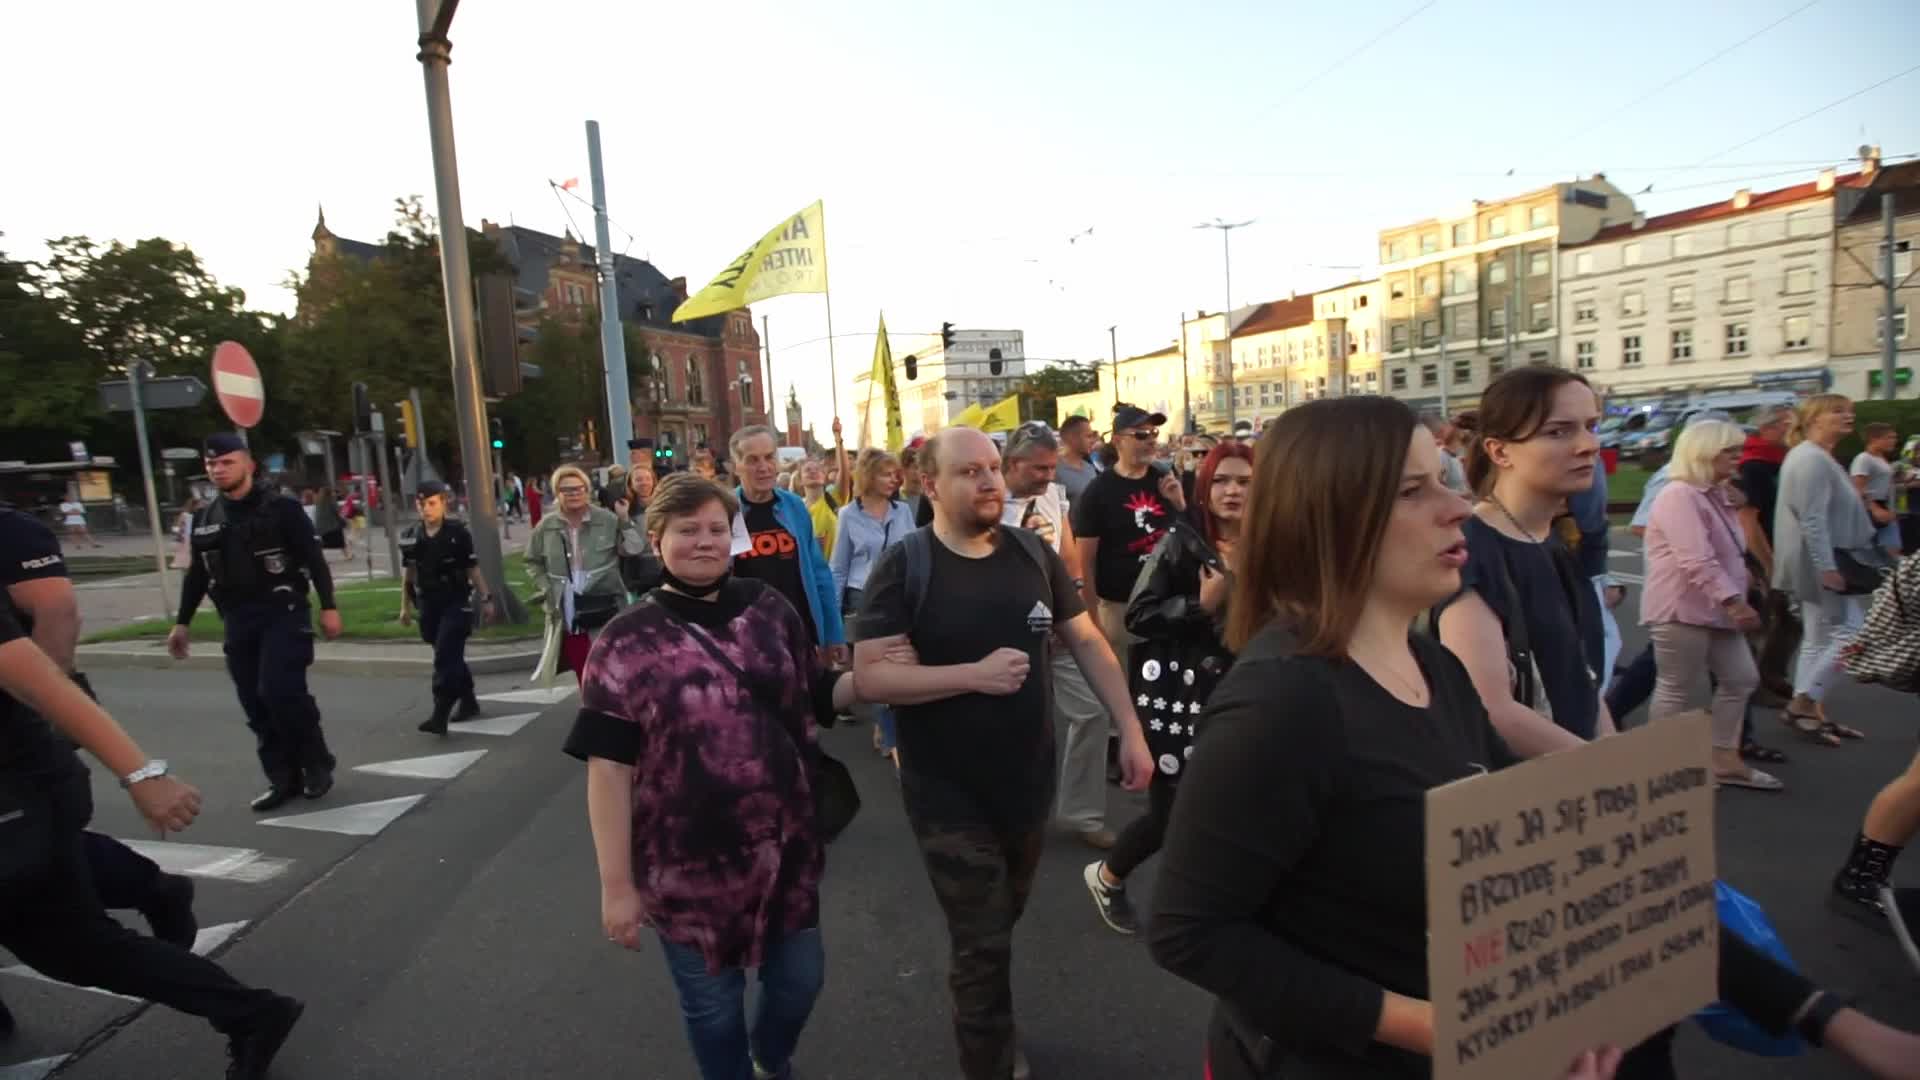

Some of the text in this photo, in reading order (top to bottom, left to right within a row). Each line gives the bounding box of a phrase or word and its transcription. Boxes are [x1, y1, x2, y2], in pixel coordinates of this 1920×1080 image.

[1450, 820, 1502, 868] JAK
[1514, 808, 1545, 847] JA
[1553, 797, 1586, 836] SIĘ
[1611, 832, 1637, 869] JA
[1563, 876, 1633, 932] DOBRZE
[1457, 977, 1500, 1023] JAK
[1507, 962, 1533, 1001] JA
